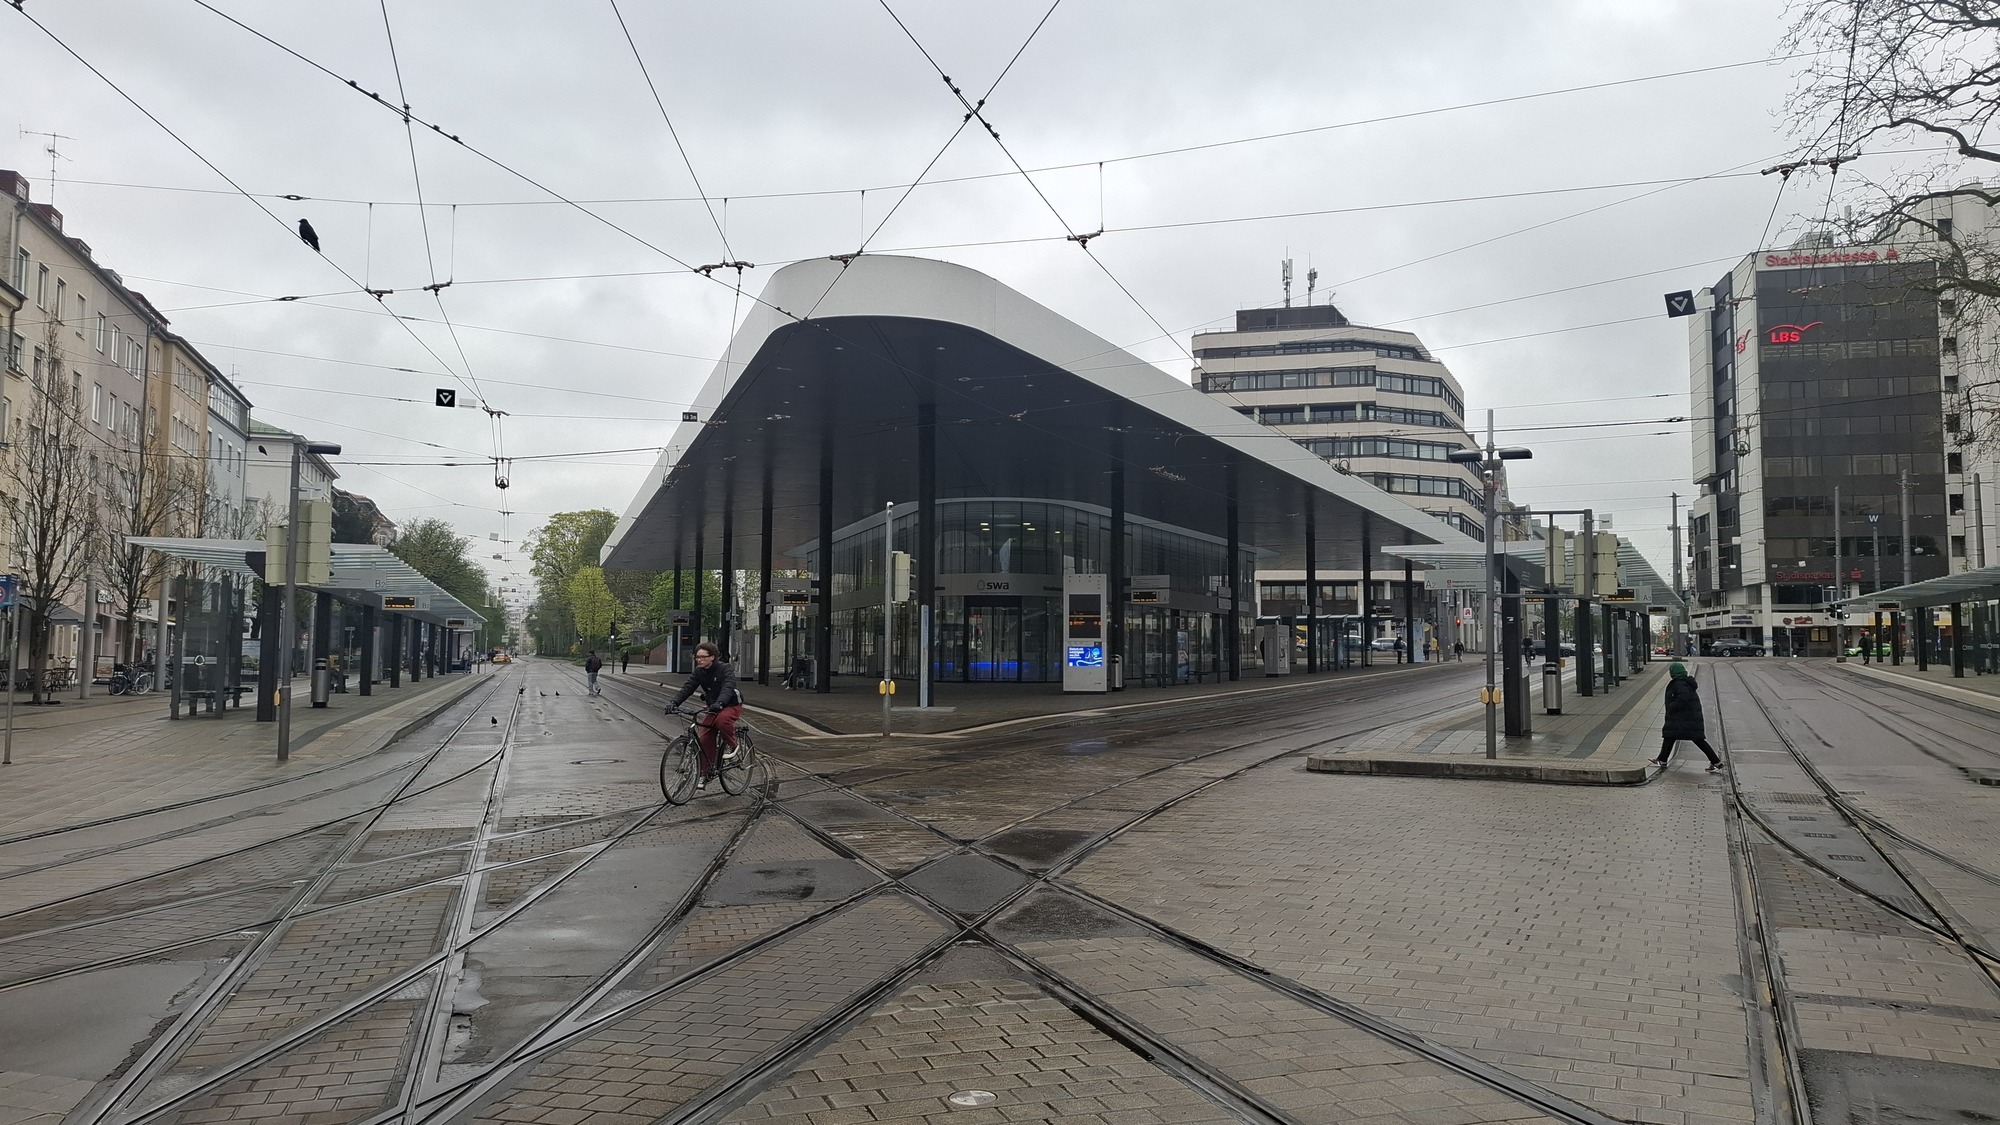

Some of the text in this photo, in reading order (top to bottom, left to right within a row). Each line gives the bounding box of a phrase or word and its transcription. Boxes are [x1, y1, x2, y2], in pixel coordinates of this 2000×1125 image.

[1765, 250, 1878, 267] Stadtsparkasse
[1771, 331, 1801, 343] LBS
[1868, 515, 1879, 523] W
[1776, 571, 1847, 581] Stadtsparkase
[375, 580, 386, 588] B2
[986, 582, 1010, 590] swa
[1426, 580, 1437, 588] A2
